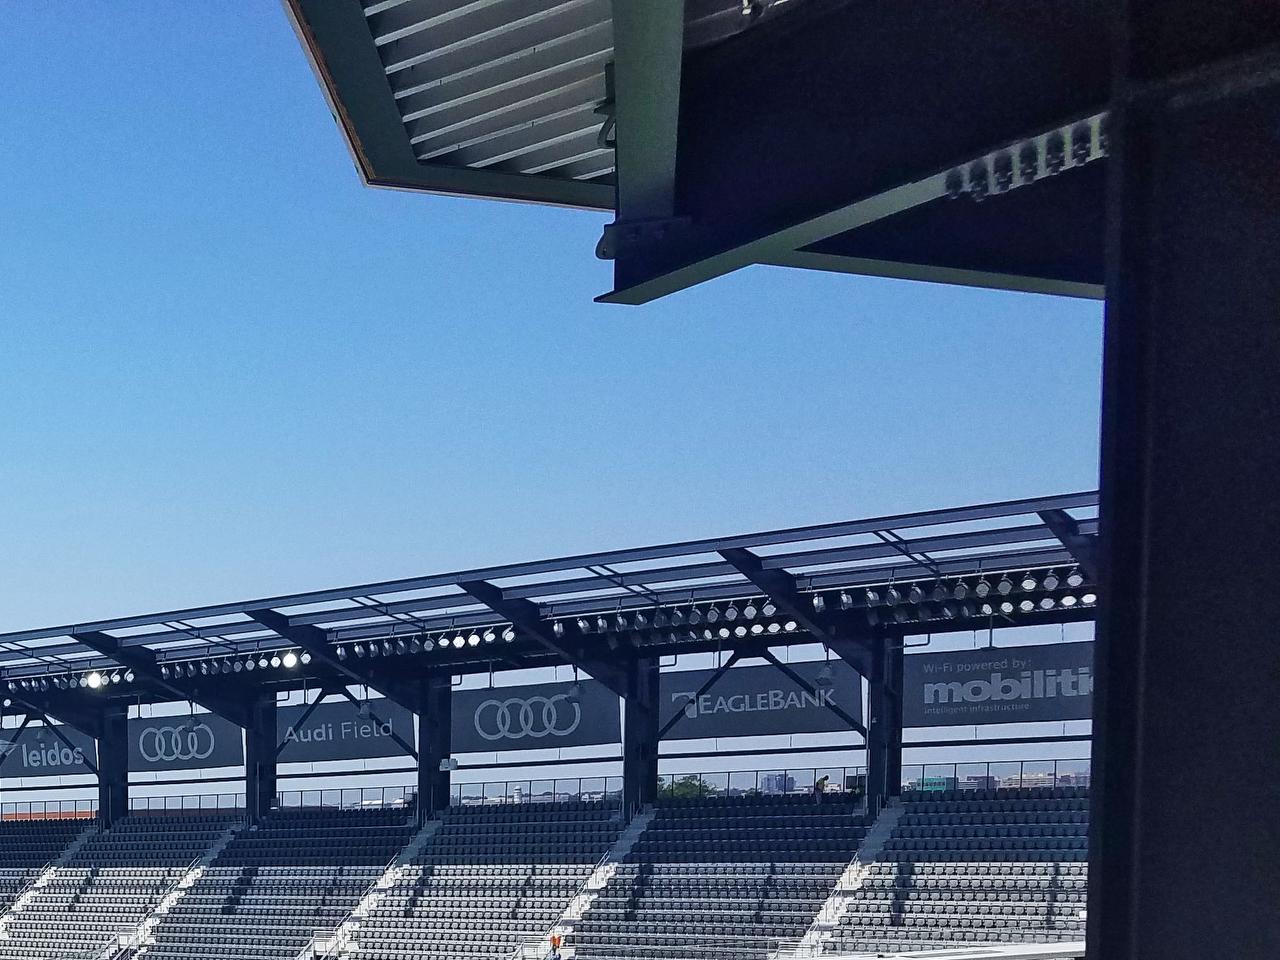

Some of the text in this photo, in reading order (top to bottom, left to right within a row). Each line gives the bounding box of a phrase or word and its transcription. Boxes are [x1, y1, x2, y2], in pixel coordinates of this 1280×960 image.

[923, 663, 953, 673] Wi-Fi
[957, 659, 1008, 672] powered
[924, 667, 1094, 704] mobiliti
[284, 717, 393, 743] Audi Field
[22, 741, 84, 767] leidos
